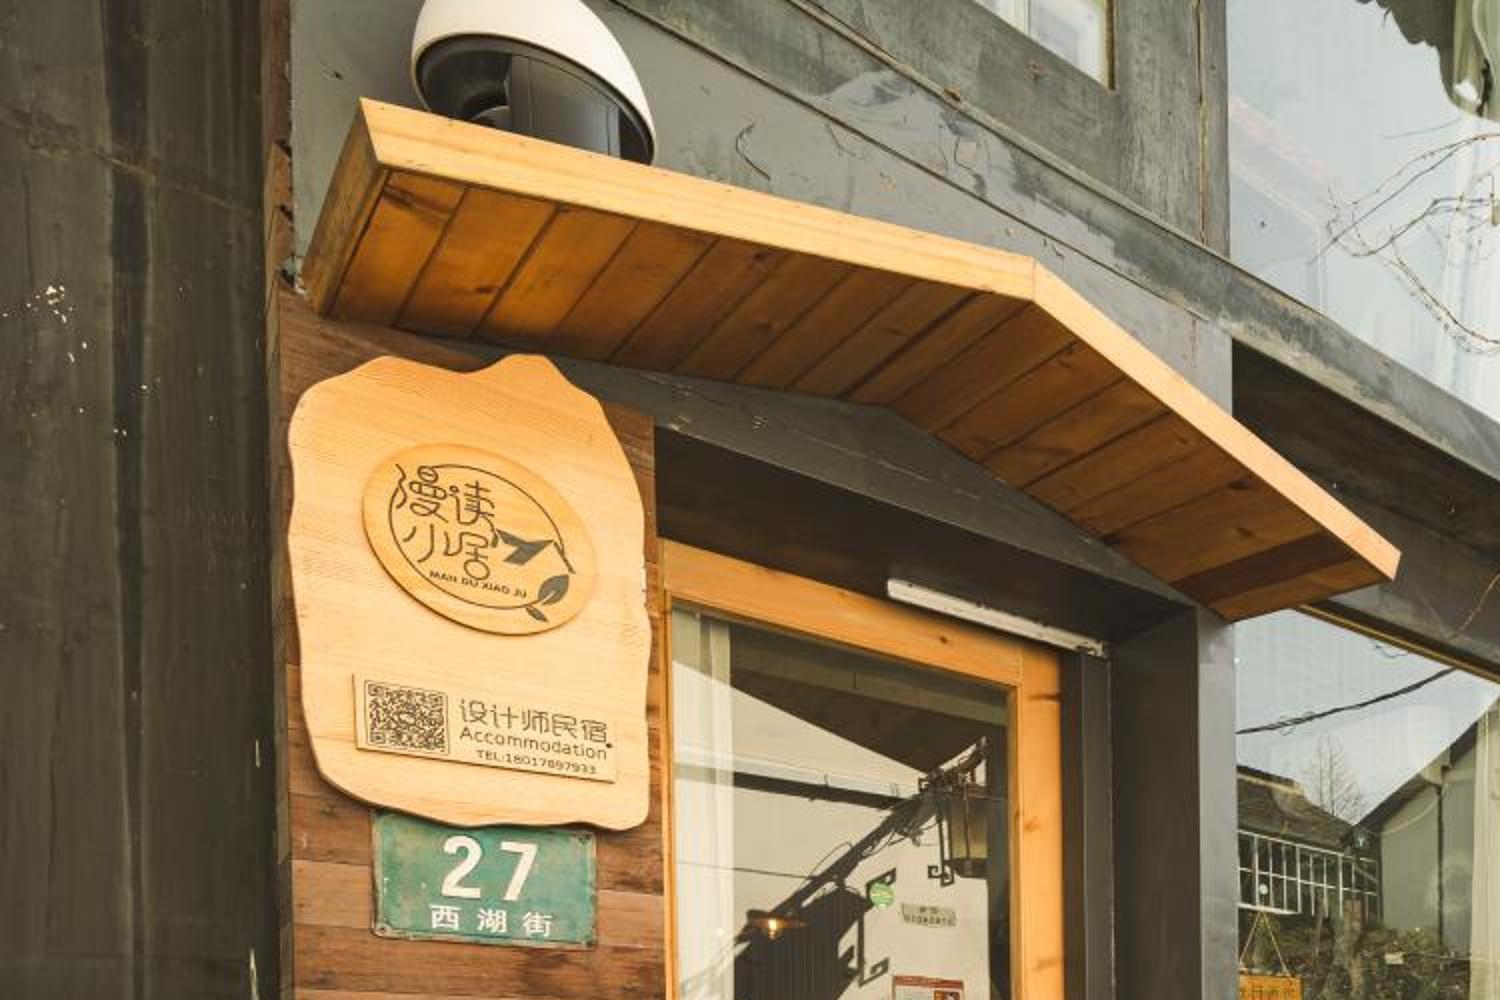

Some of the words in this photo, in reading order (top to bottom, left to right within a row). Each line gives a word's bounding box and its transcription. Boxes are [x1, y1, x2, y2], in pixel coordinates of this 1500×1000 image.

[459, 698, 608, 743] 设计师民宿
[459, 726, 607, 761] Accommodation
[441, 835, 539, 901] 27
[429, 904, 554, 938] 西湖街
